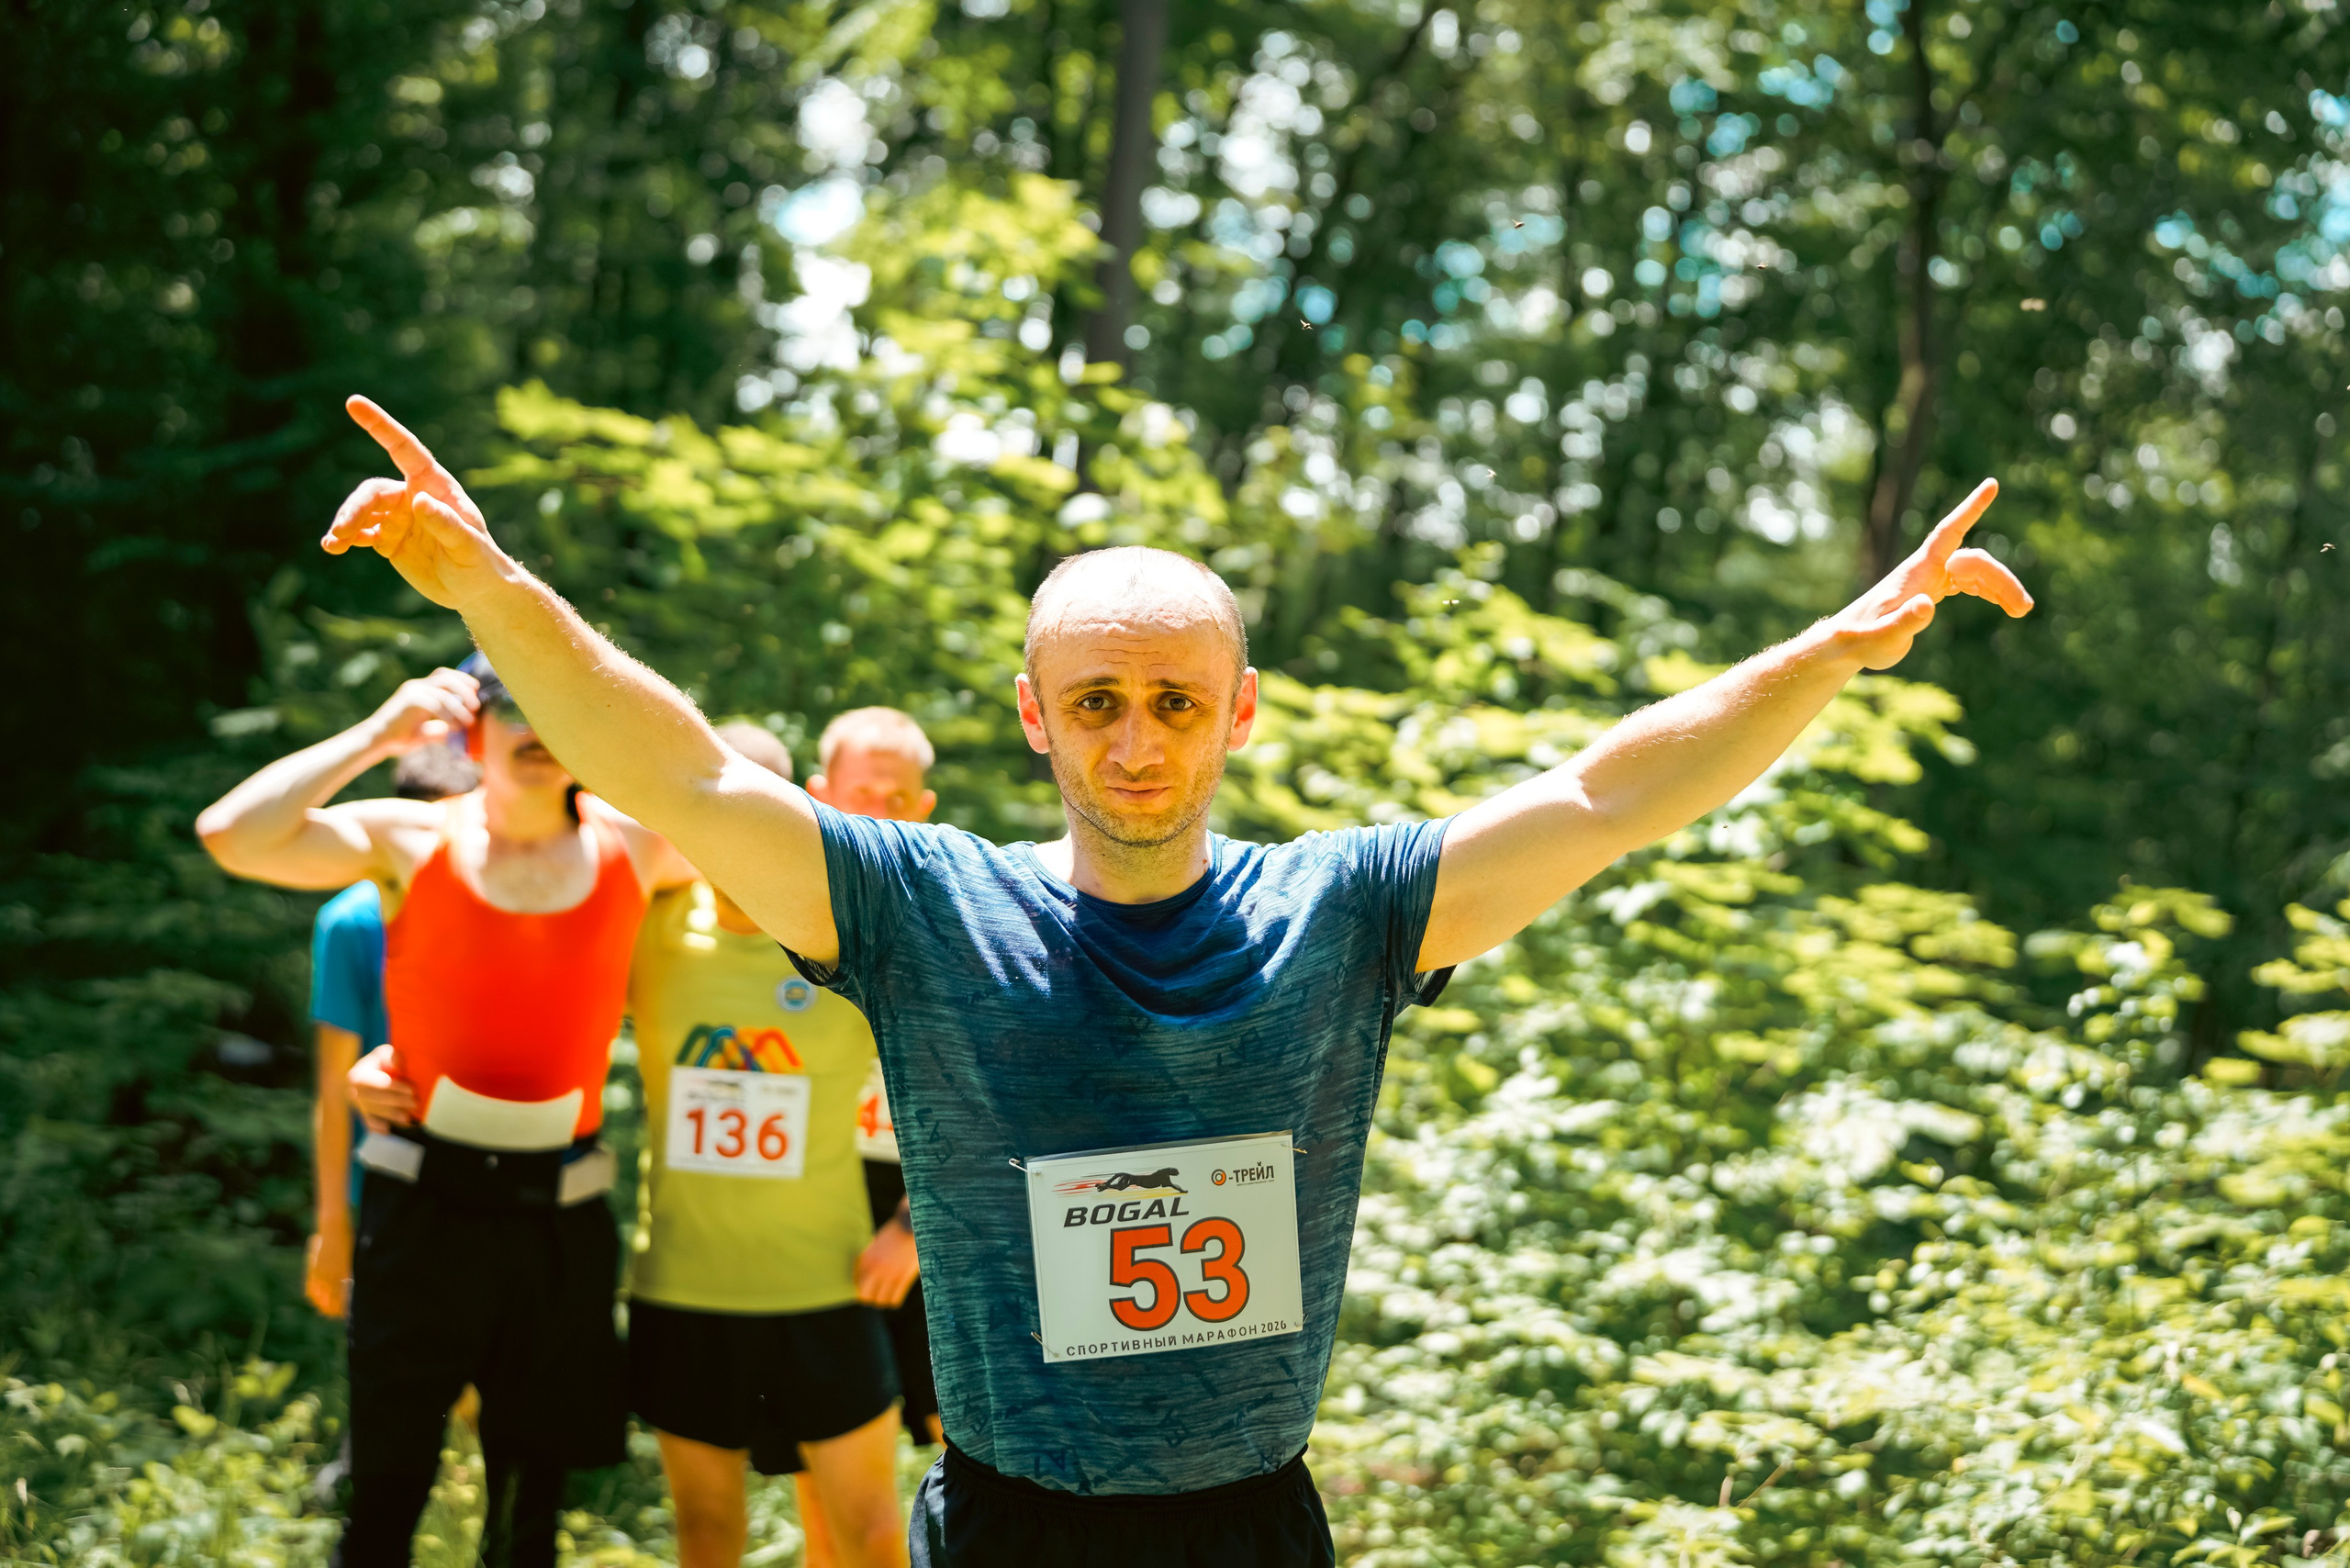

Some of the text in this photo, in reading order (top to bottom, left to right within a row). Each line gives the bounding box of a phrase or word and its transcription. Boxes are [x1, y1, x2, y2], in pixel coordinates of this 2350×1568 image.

[687, 1106, 789, 1161] 136
[1063, 1196, 1190, 1228] BOGAL
[1109, 1215, 1250, 1332] 53
[1066, 1335, 1177, 1356] СПОРТИВНЫЙ
[1182, 1324, 1258, 1345] МАРАФОН
